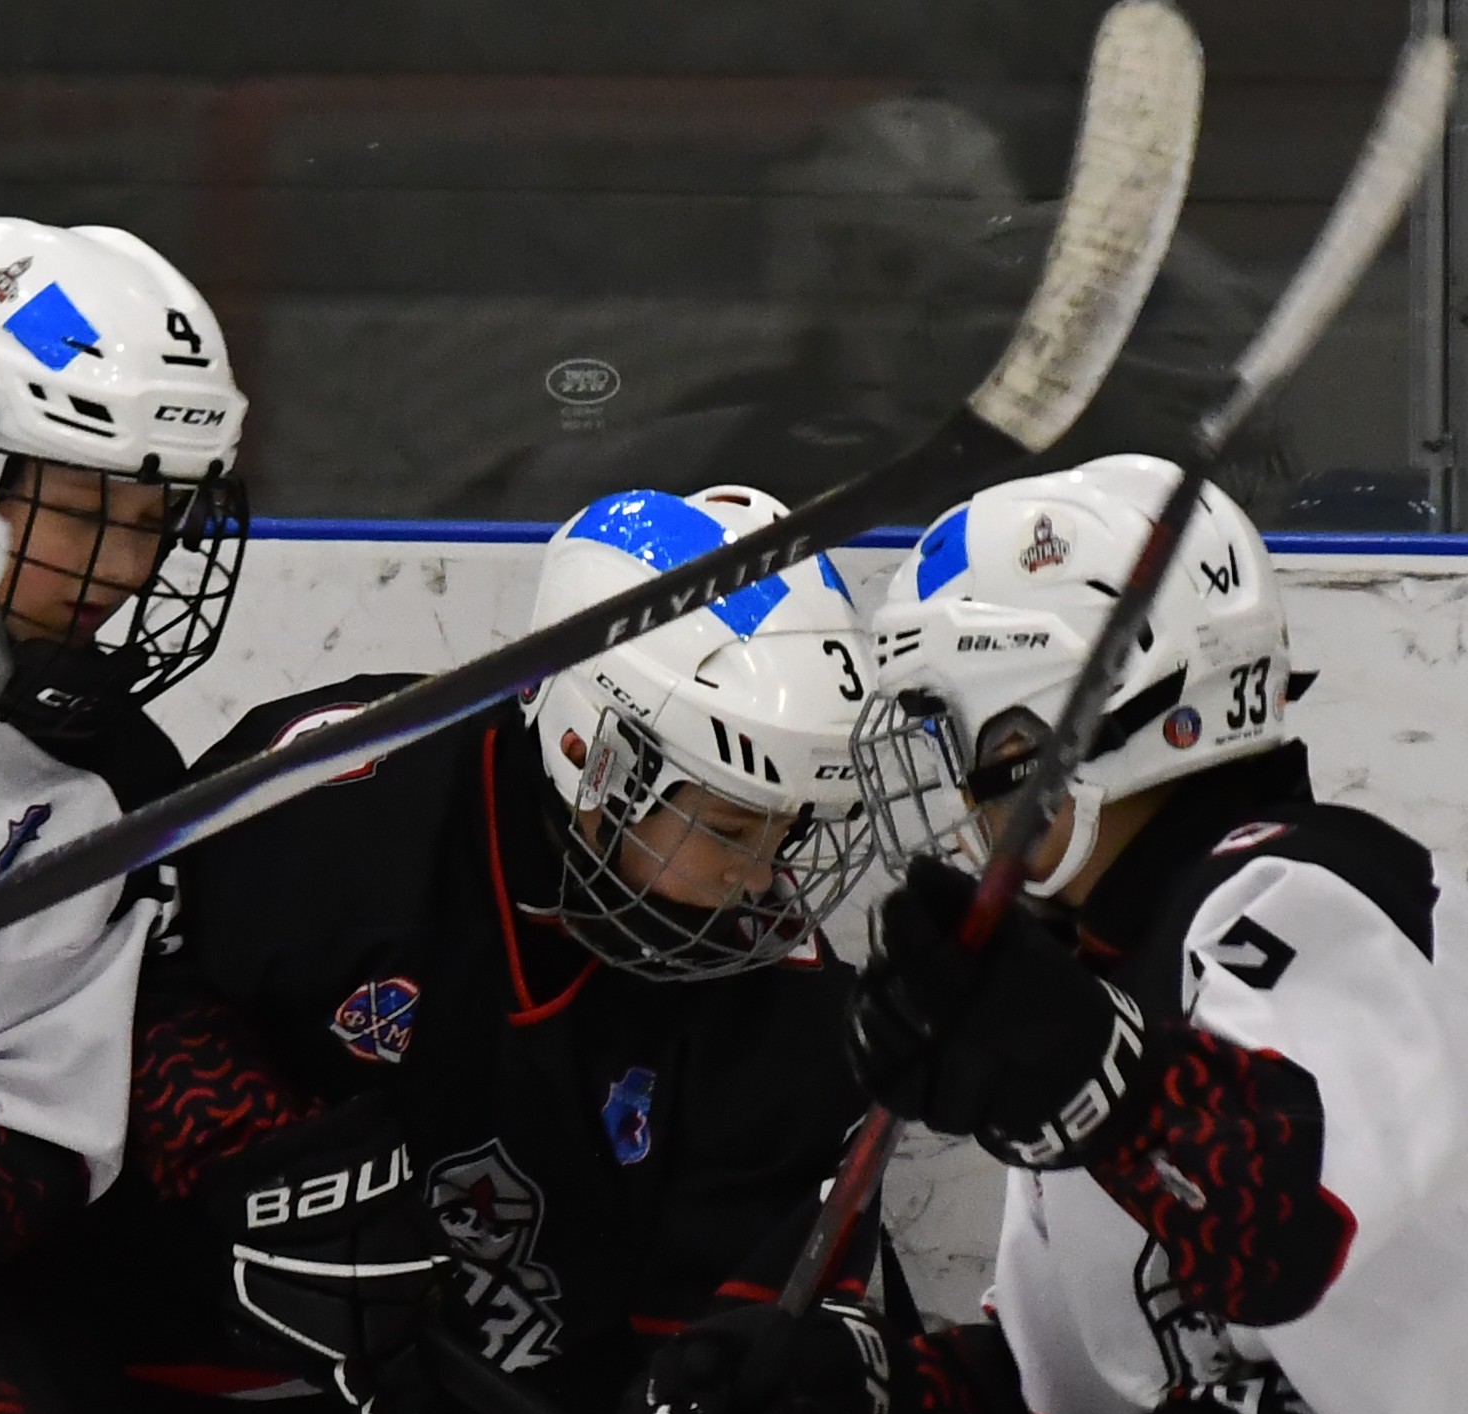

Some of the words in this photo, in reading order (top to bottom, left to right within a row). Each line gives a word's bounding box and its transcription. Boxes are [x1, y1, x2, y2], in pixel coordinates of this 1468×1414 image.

[166, 307, 202, 354] 4
[155, 405, 226, 426] CCM
[606, 534, 810, 645] FLYLITE
[822, 639, 864, 701] 3
[1226, 656, 1271, 729] 33
